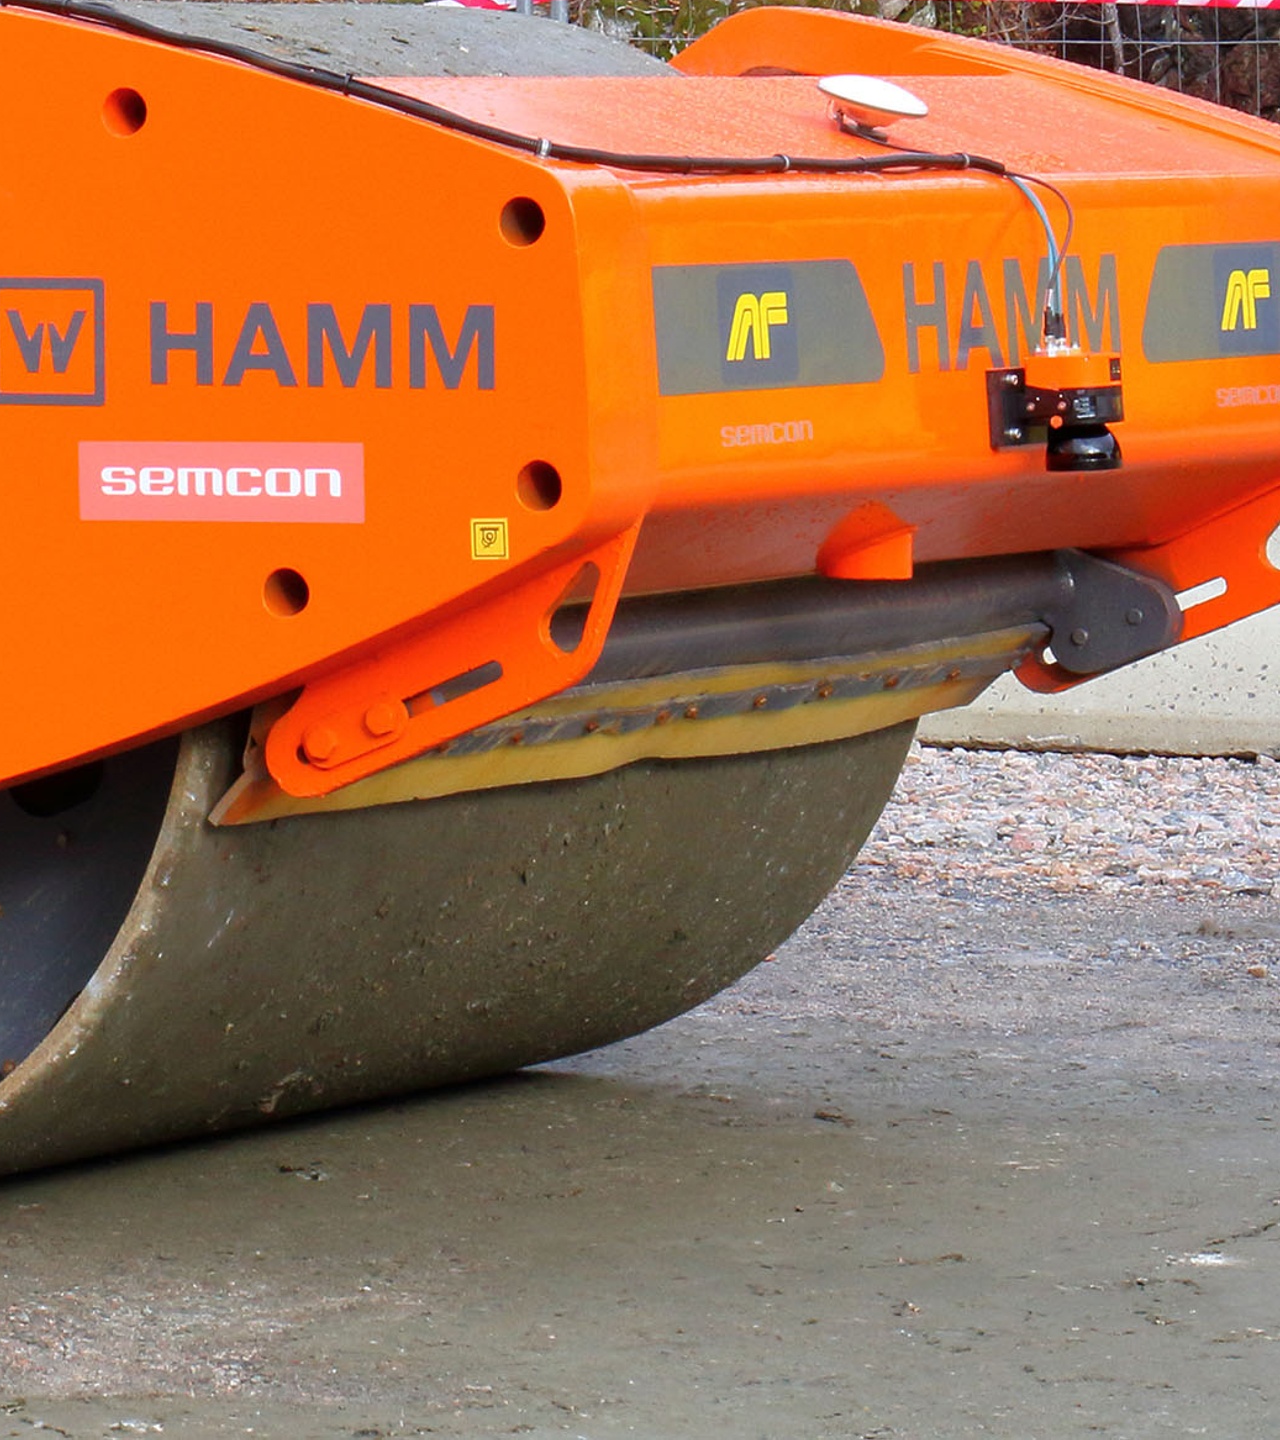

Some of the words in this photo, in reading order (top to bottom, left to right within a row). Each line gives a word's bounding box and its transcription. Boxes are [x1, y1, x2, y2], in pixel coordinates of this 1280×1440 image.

[726, 291, 788, 361] AF
[902, 253, 1122, 374] HAMM
[1221, 269, 1270, 330] AF
[149, 301, 495, 390] HAMM
[720, 419, 814, 448] semcon
[101, 466, 342, 497] semcon
